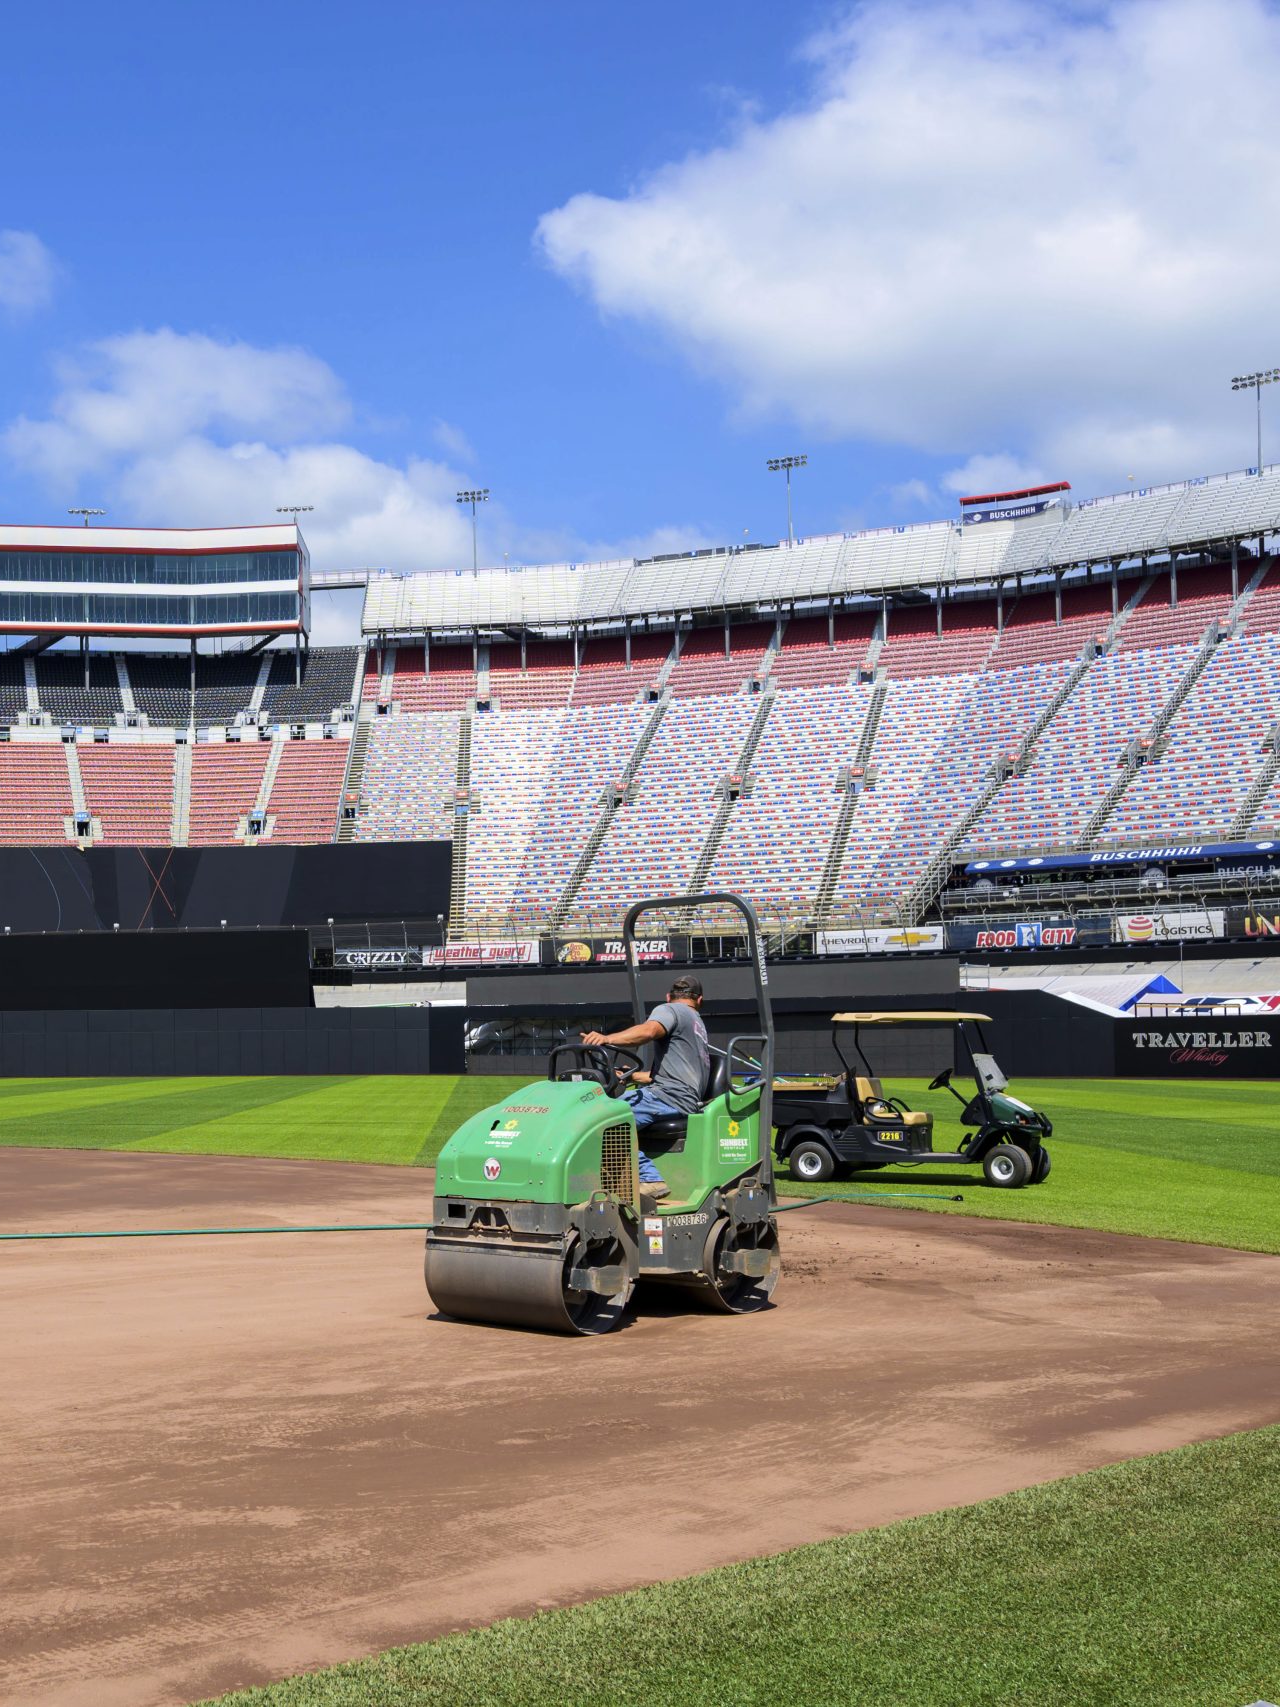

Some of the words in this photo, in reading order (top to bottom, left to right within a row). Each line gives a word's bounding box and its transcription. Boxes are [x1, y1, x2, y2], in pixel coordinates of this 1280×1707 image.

[1091, 846, 1202, 861] BUSCHHHHH
[977, 931, 1016, 948] FOOD
[1041, 927, 1076, 945] CITY
[1154, 926, 1213, 936] LOGISTICS
[821, 937, 880, 945] CHEVROLET
[346, 951, 407, 964] GRIZZLY
[434, 946, 486, 959] weather
[489, 945, 526, 957] guard
[1132, 1031, 1272, 1048] TRAVELLER
[1170, 1047, 1229, 1066] Whiskey
[503, 1105, 550, 1114] 10038736
[880, 1132, 900, 1140] 2216
[667, 1214, 706, 1227] 10038736
